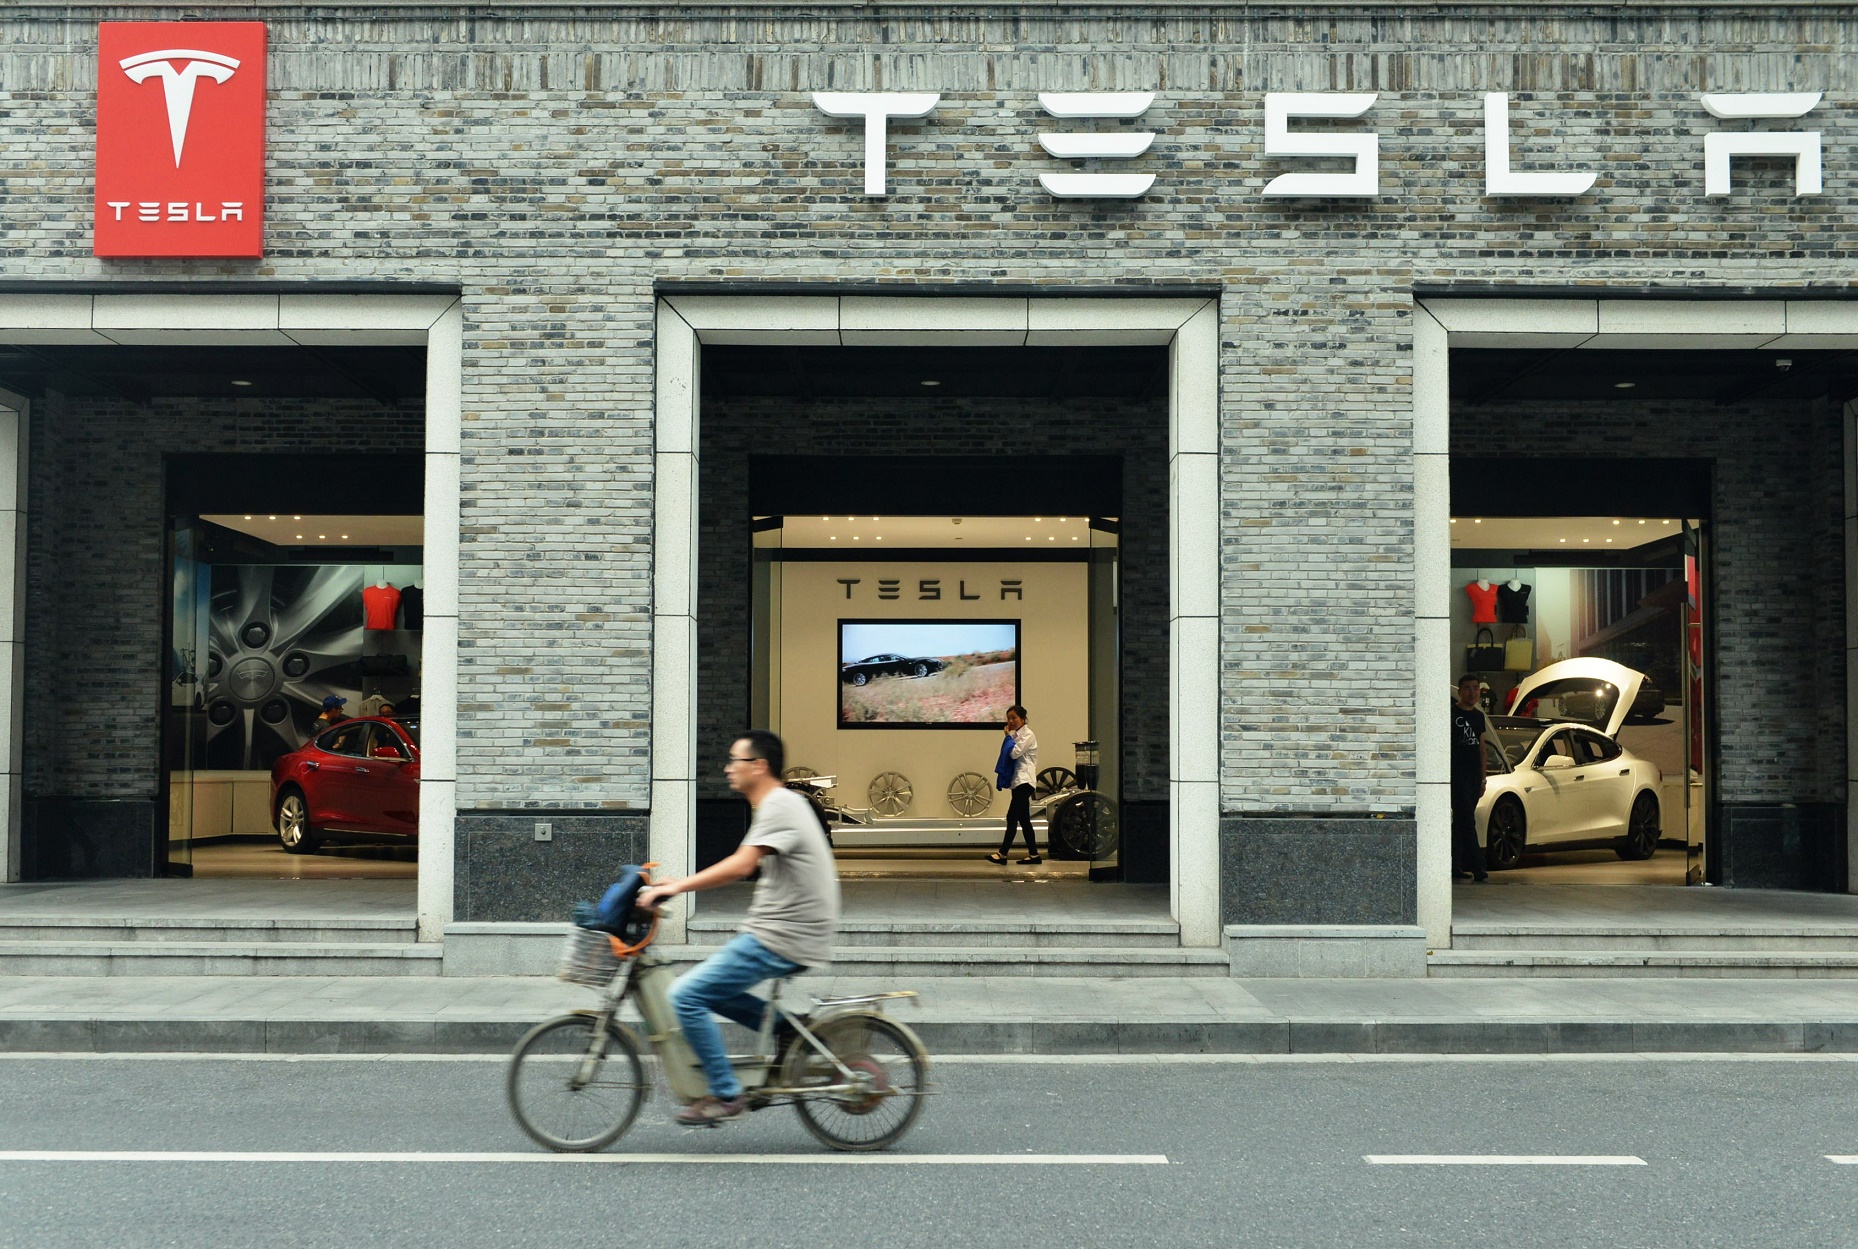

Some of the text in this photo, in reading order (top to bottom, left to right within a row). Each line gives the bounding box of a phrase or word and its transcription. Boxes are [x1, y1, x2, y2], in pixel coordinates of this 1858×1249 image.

[812, 93, 1822, 196] TESLA
[108, 202, 242, 221] TESLA
[837, 578, 1023, 601] TESLA
